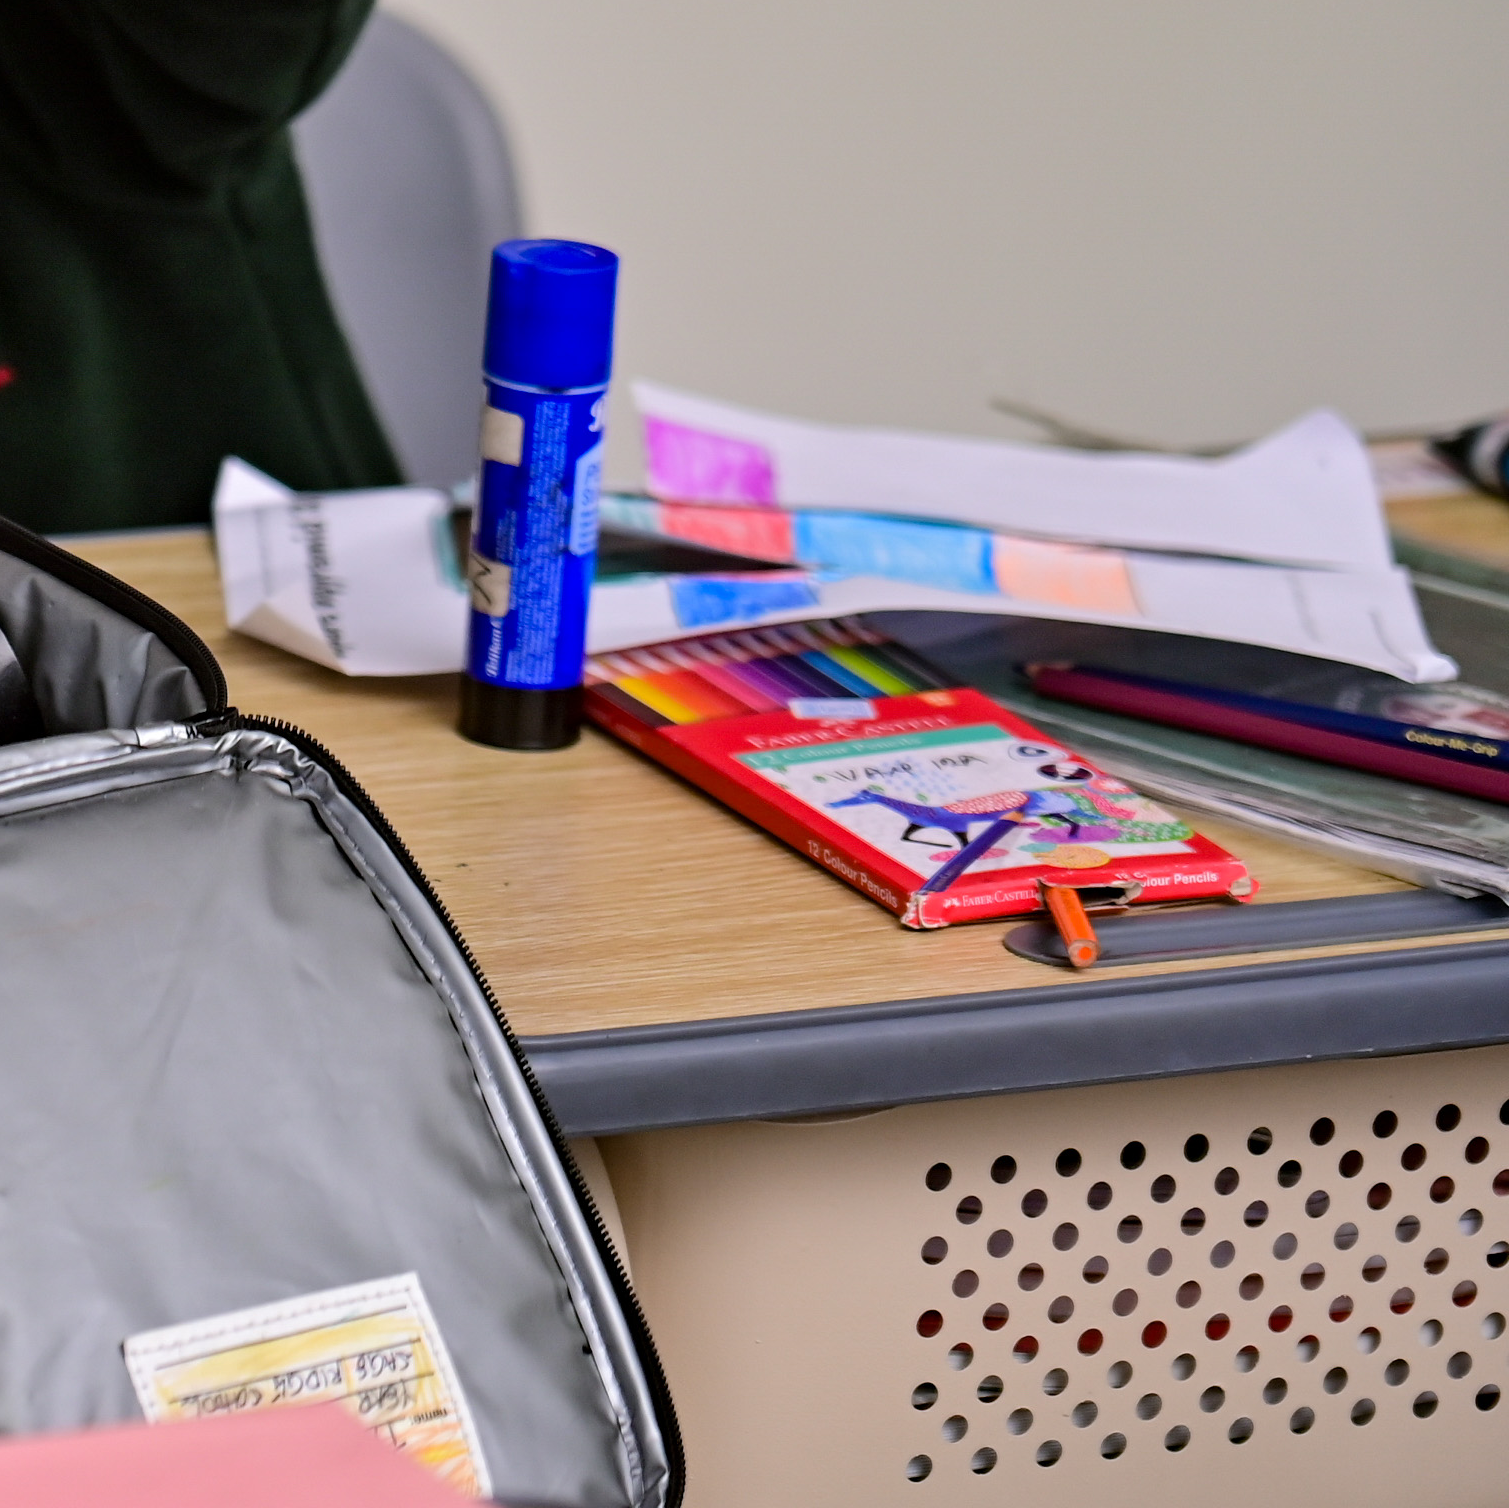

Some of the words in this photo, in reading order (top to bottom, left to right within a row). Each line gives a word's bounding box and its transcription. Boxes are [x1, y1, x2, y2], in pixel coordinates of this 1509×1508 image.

[807, 839, 820, 860] 12
[822, 848, 859, 882] Colour
[859, 871, 899, 910] Pencils
[1173, 870, 1219, 885] Pencils
